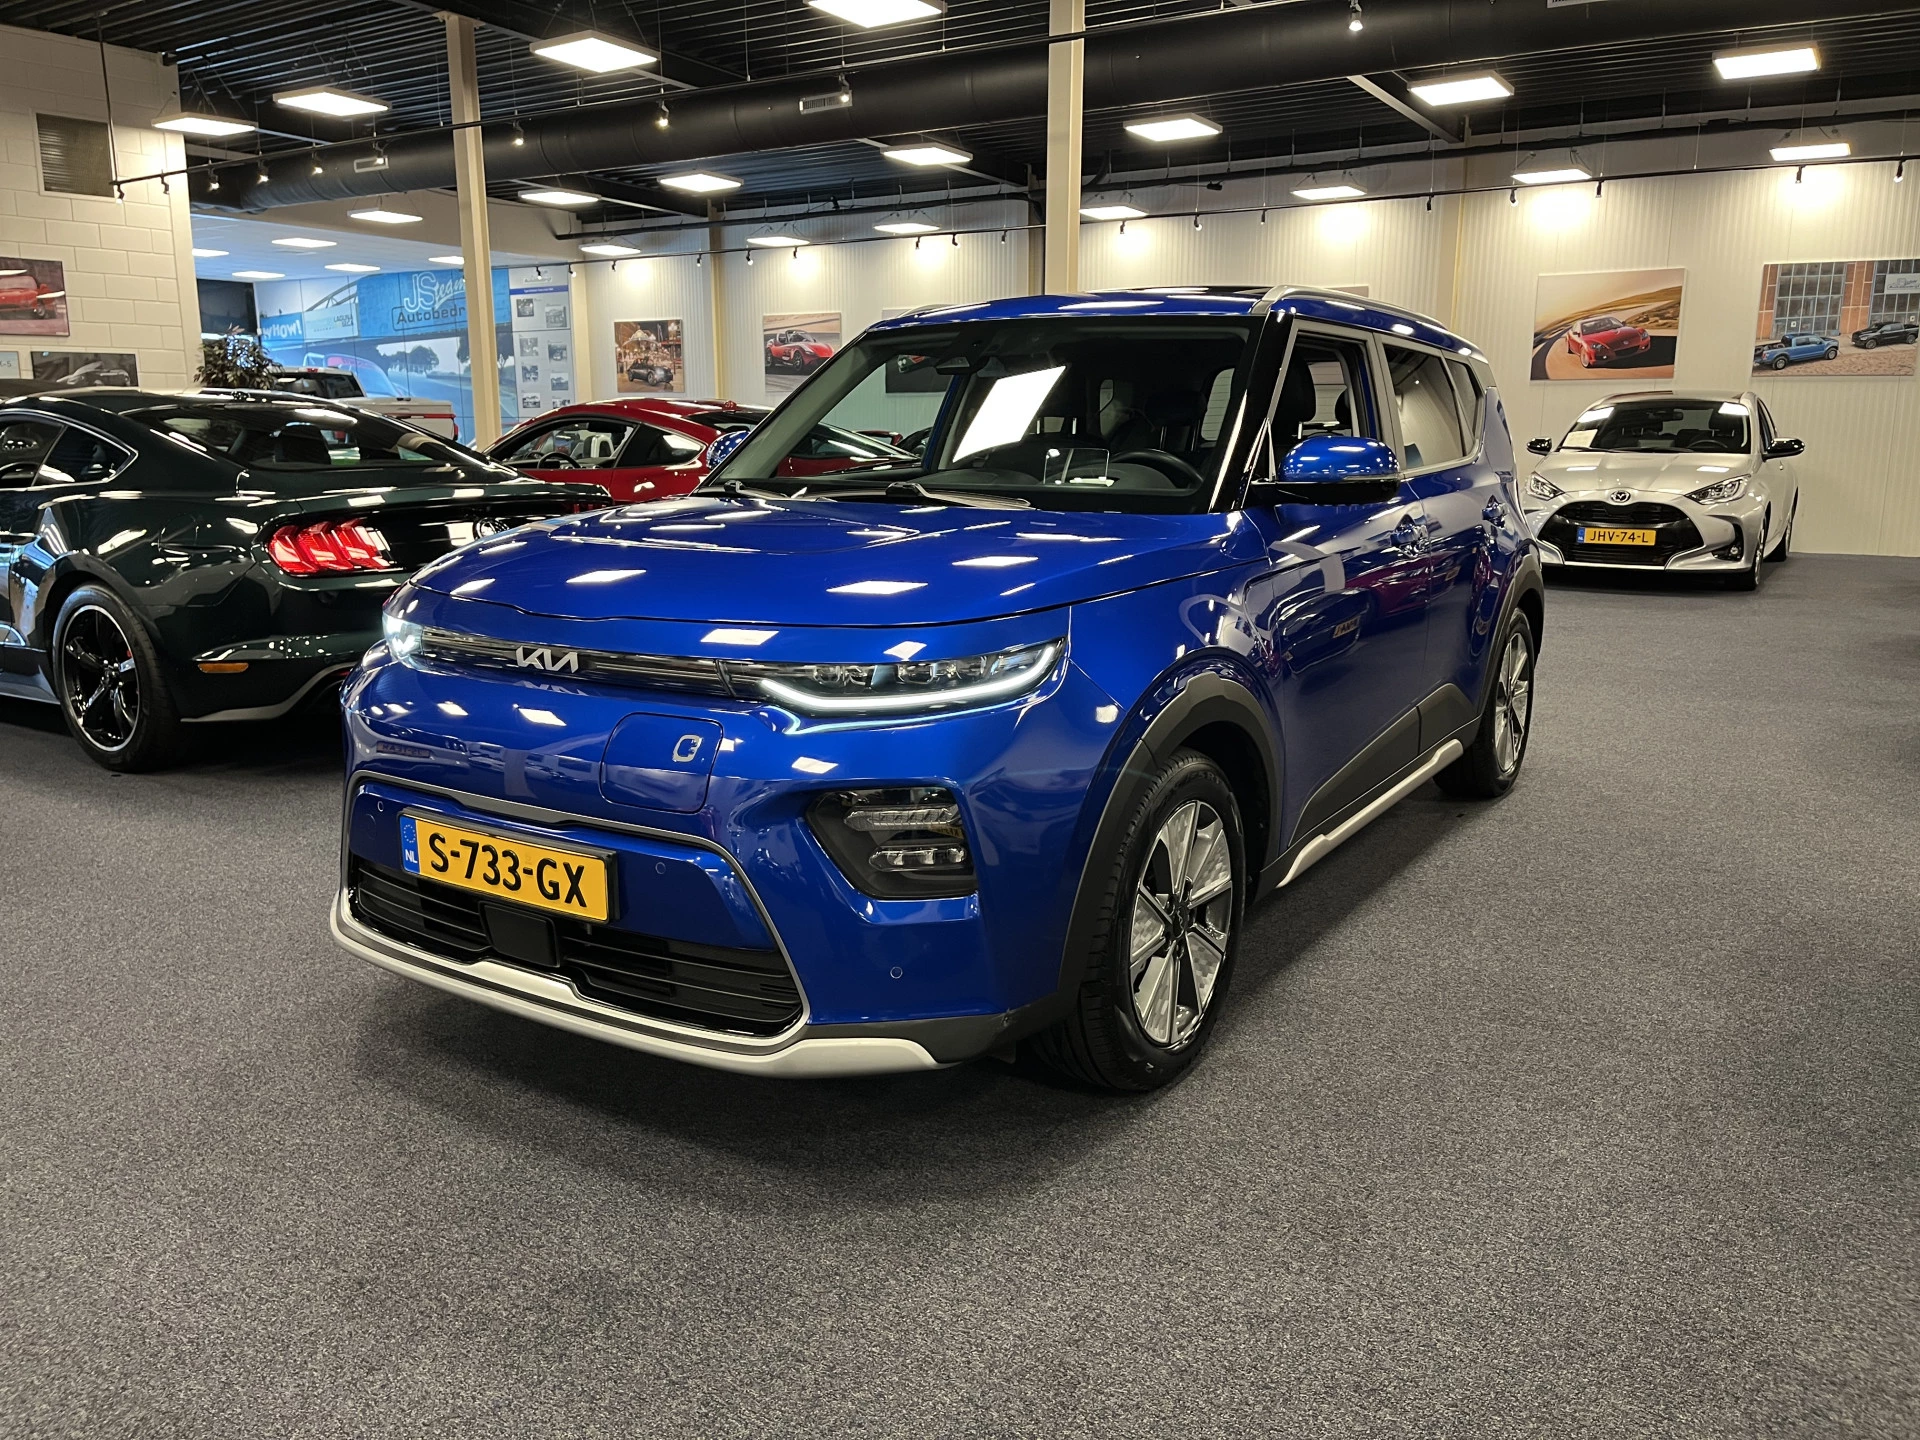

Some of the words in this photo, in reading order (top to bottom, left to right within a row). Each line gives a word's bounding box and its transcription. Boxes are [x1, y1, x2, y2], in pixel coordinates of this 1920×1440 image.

[1590, 531, 1649, 543] JHV-74-L
[405, 849, 418, 864] NL
[429, 832, 587, 908] S-733-GX
